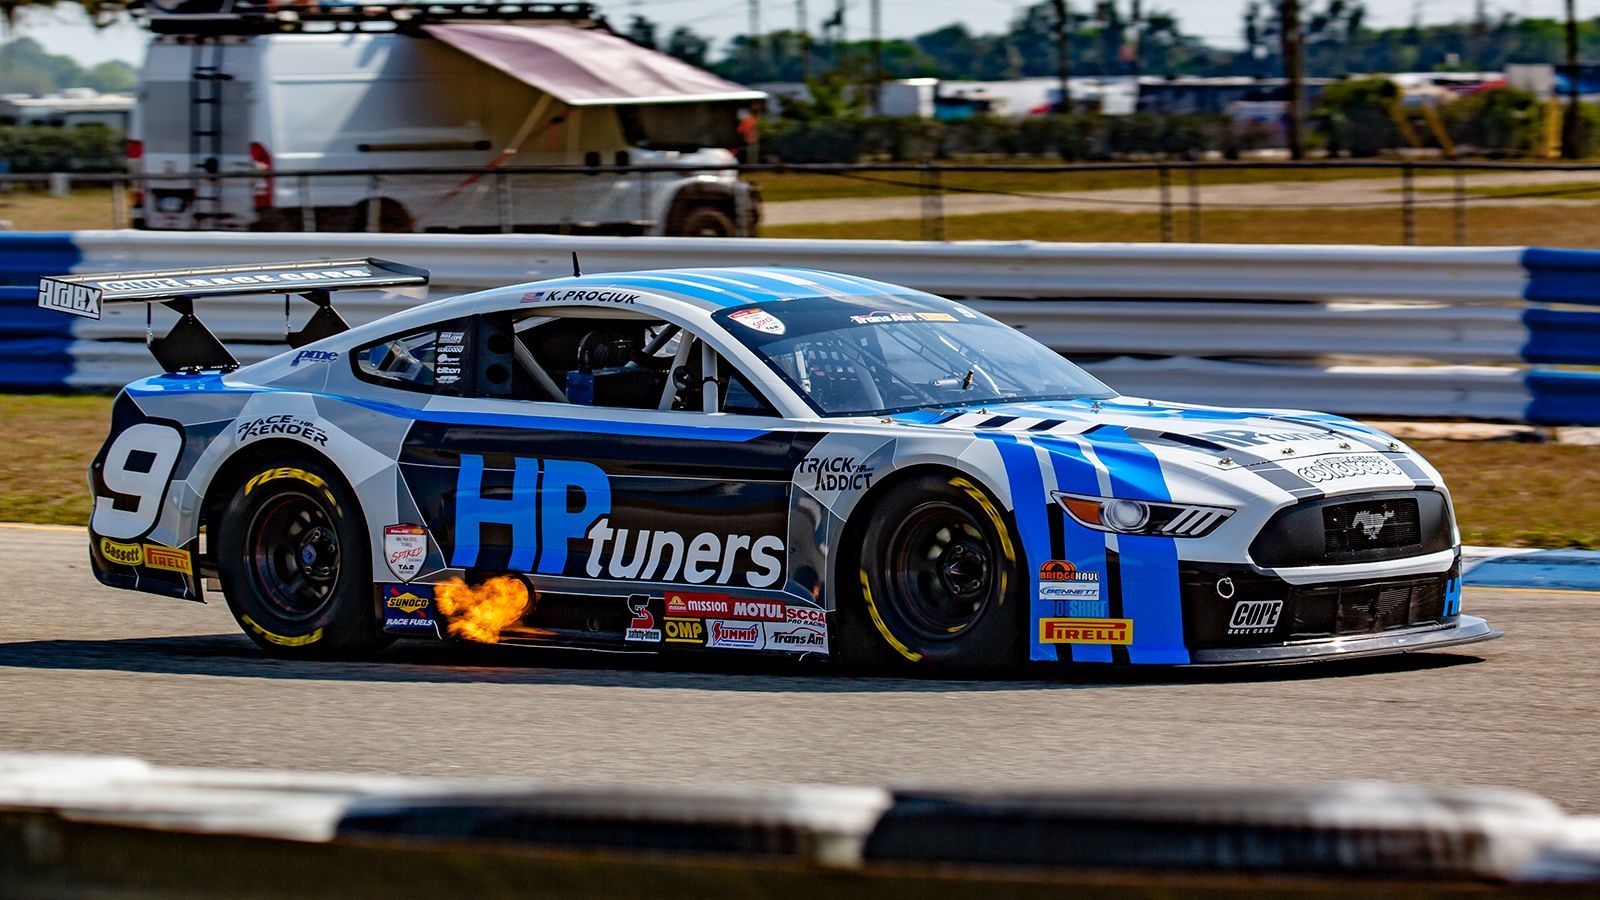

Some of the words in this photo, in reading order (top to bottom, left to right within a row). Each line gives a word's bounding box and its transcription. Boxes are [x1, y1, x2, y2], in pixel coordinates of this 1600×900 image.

[184, 275, 279, 287] RACE
[279, 270, 372, 281] CARS
[38, 278, 101, 319] ardex
[546, 290, 640, 304] K.PROCIUK
[290, 350, 339, 367] pme
[247, 424, 329, 447] RENDER
[800, 457, 856, 474] TRACK
[92, 422, 183, 540] 9
[814, 473, 873, 491] ADDICT
[450, 453, 612, 575] HP
[585, 518, 785, 588] tuners
[104, 543, 140, 562] Bassett
[147, 547, 189, 570] PIRELLI
[1040, 571, 1099, 581] BRIDGEHAUL
[389, 598, 428, 608] SUNOCO
[1442, 577, 1461, 617] H
[687, 600, 728, 612] MISSION
[733, 602, 784, 618] MOTUL
[1232, 602, 1282, 626] COPE
[386, 618, 408, 626] RACE
[409, 618, 433, 627] FUELS
[786, 608, 826, 623] SCCA
[665, 621, 703, 638] OMP
[713, 622, 757, 642] SUMMIT
[1045, 621, 1127, 641] PIRELLI
[772, 632, 807, 644] Trans
[806, 633, 824, 645] Am
